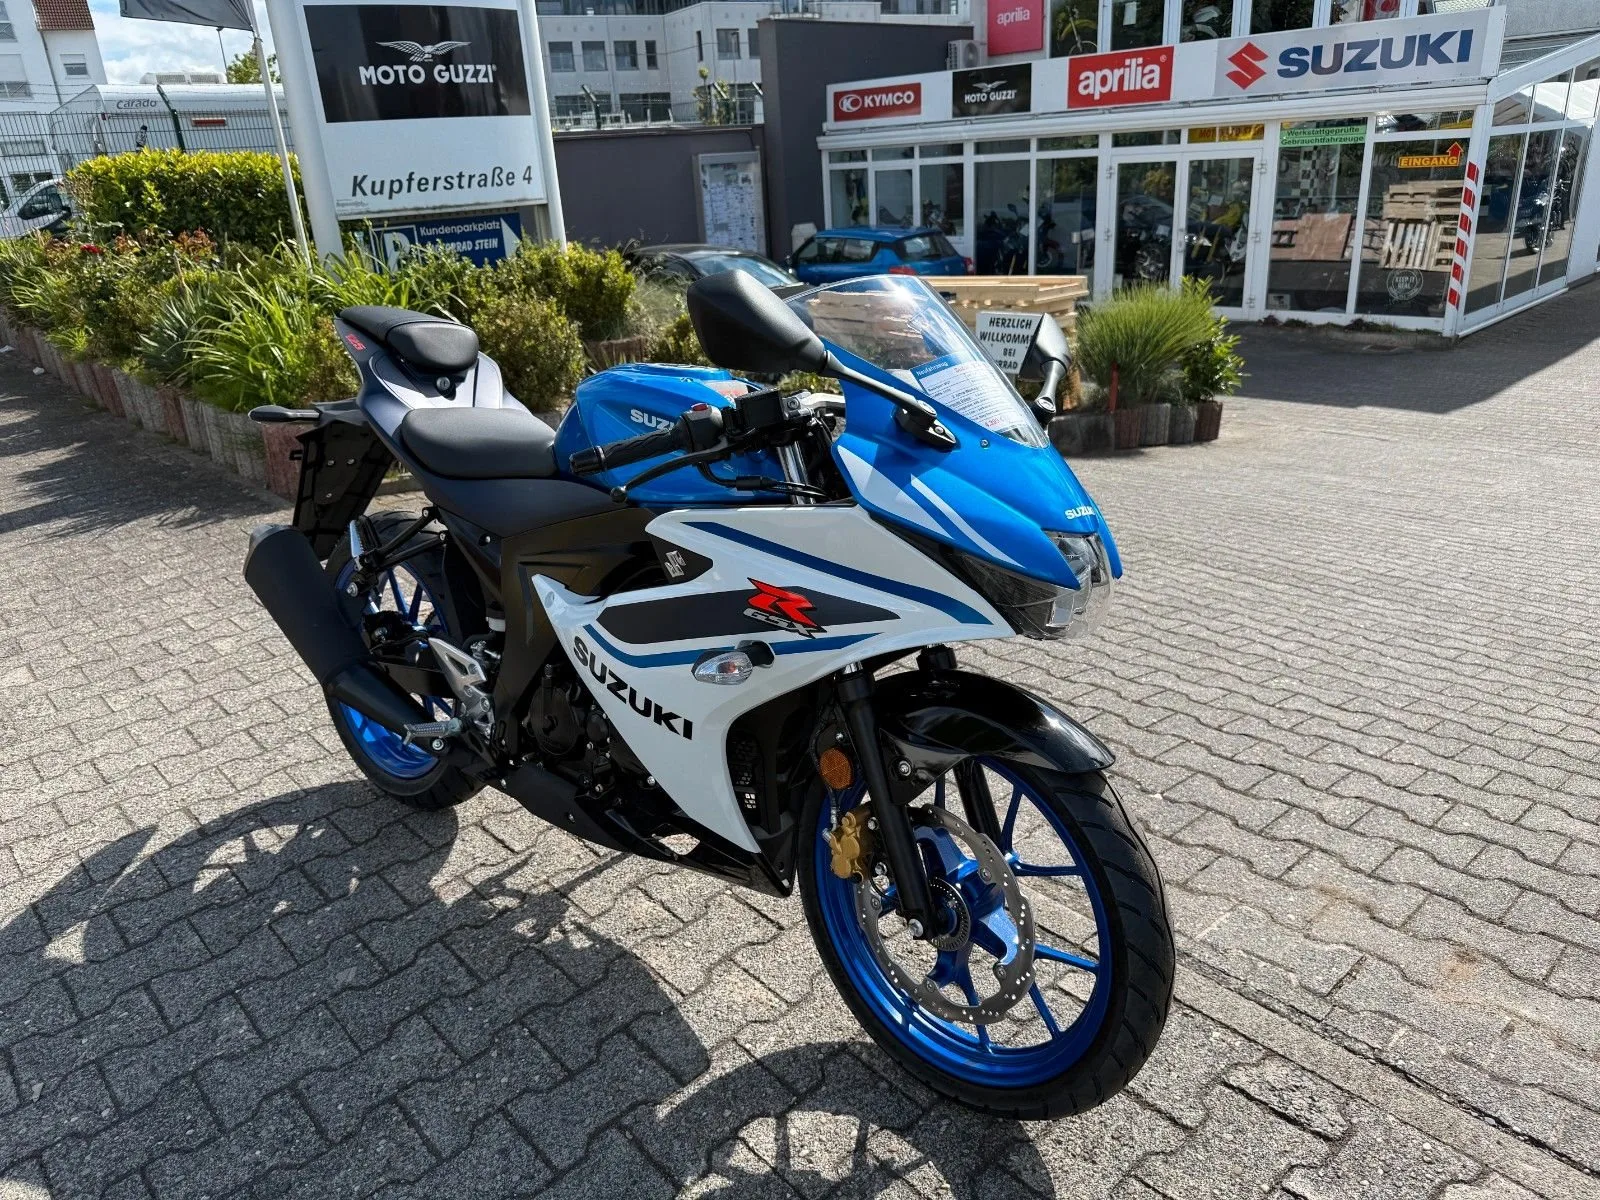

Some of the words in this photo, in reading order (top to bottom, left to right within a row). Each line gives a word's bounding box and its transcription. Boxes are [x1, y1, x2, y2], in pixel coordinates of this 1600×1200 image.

[996, 7, 1031, 26] aprilia
[1277, 29, 1474, 79] SUZUKI
[359, 65, 426, 85] MOTO
[433, 64, 494, 84] GUZZI
[1078, 57, 1161, 100] aprilia
[864, 91, 915, 108] KYMCO
[1400, 156, 1458, 167] EINGANG
[351, 166, 516, 200] Kupferstraße
[522, 165, 532, 185] 4
[420, 221, 501, 236] Kundenparkplatz
[475, 238, 499, 251] STEIN
[988, 317, 1033, 330] HERZLICH
[979, 331, 1033, 345] WILLKOMM
[1003, 347, 1017, 358] BEI
[630, 409, 675, 430] SUZ
[573, 635, 693, 741] SUZUKI
